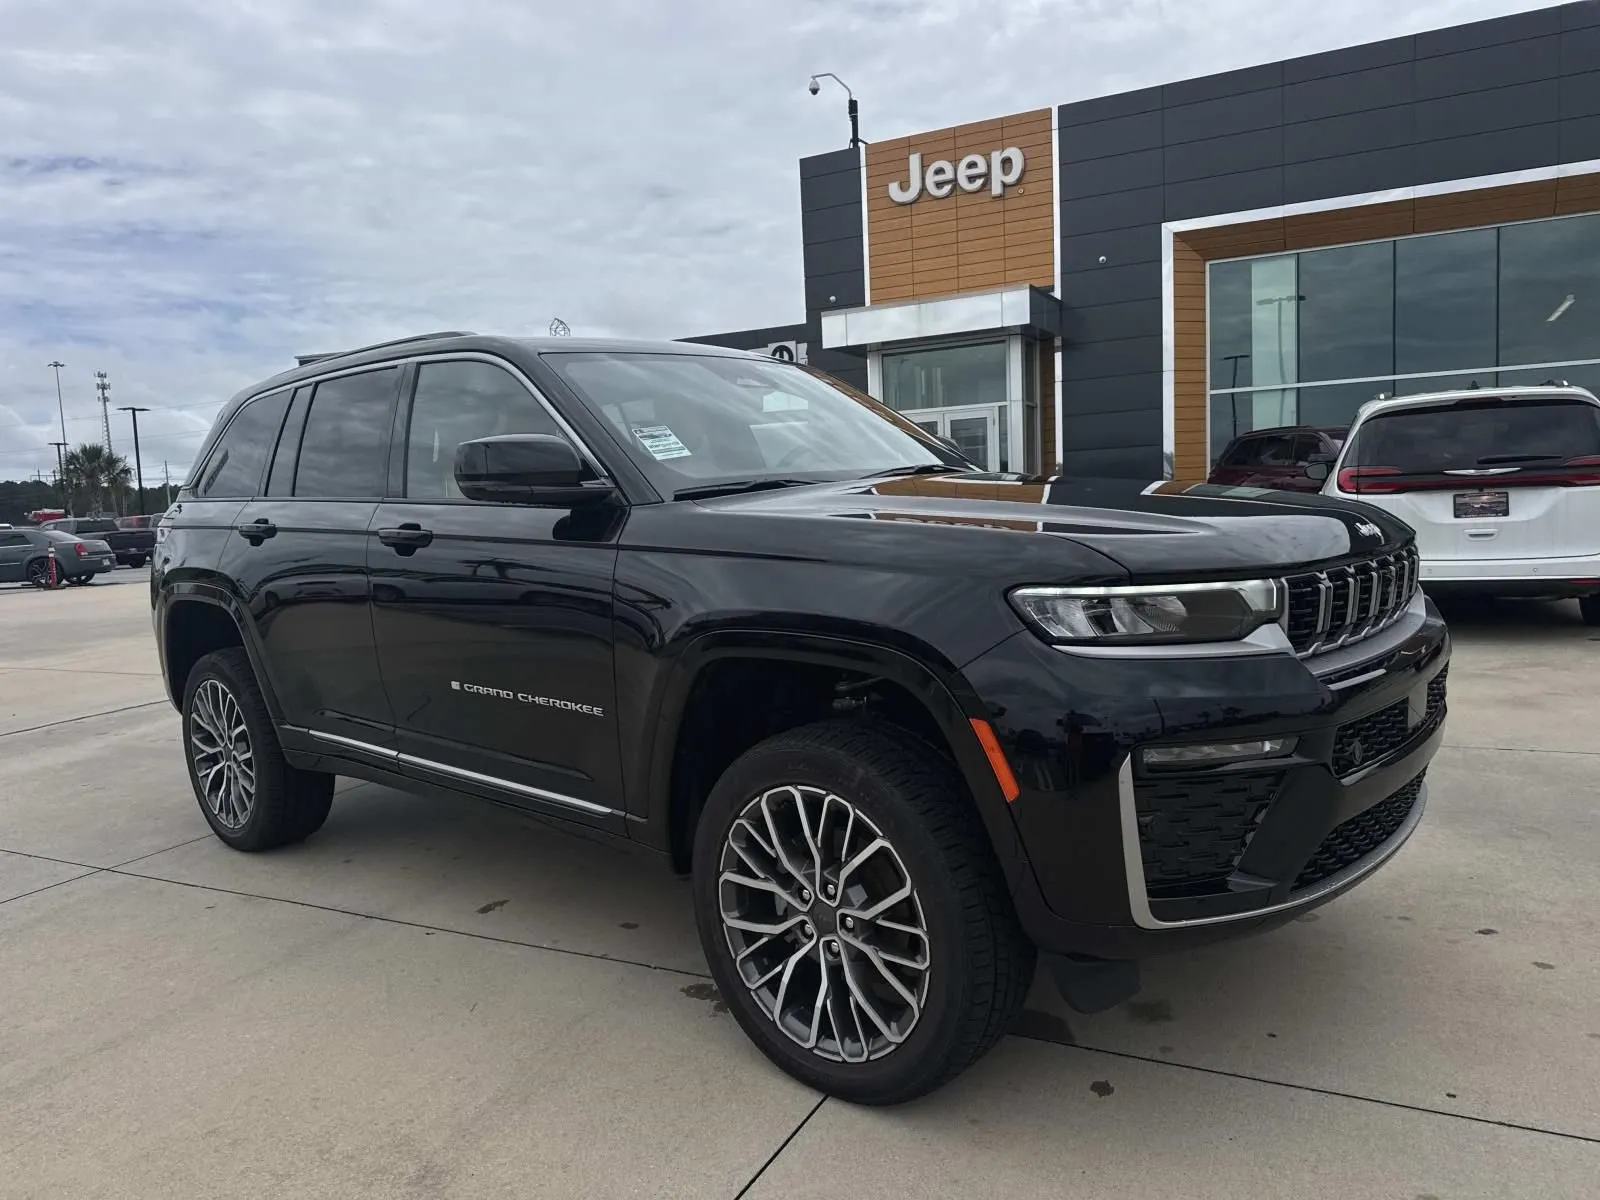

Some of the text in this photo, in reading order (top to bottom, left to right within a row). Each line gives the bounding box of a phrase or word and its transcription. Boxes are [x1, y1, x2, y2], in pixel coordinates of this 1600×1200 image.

[888, 146, 1025, 204] Jeep
[463, 683, 605, 717] GRAND CHEROKEE
